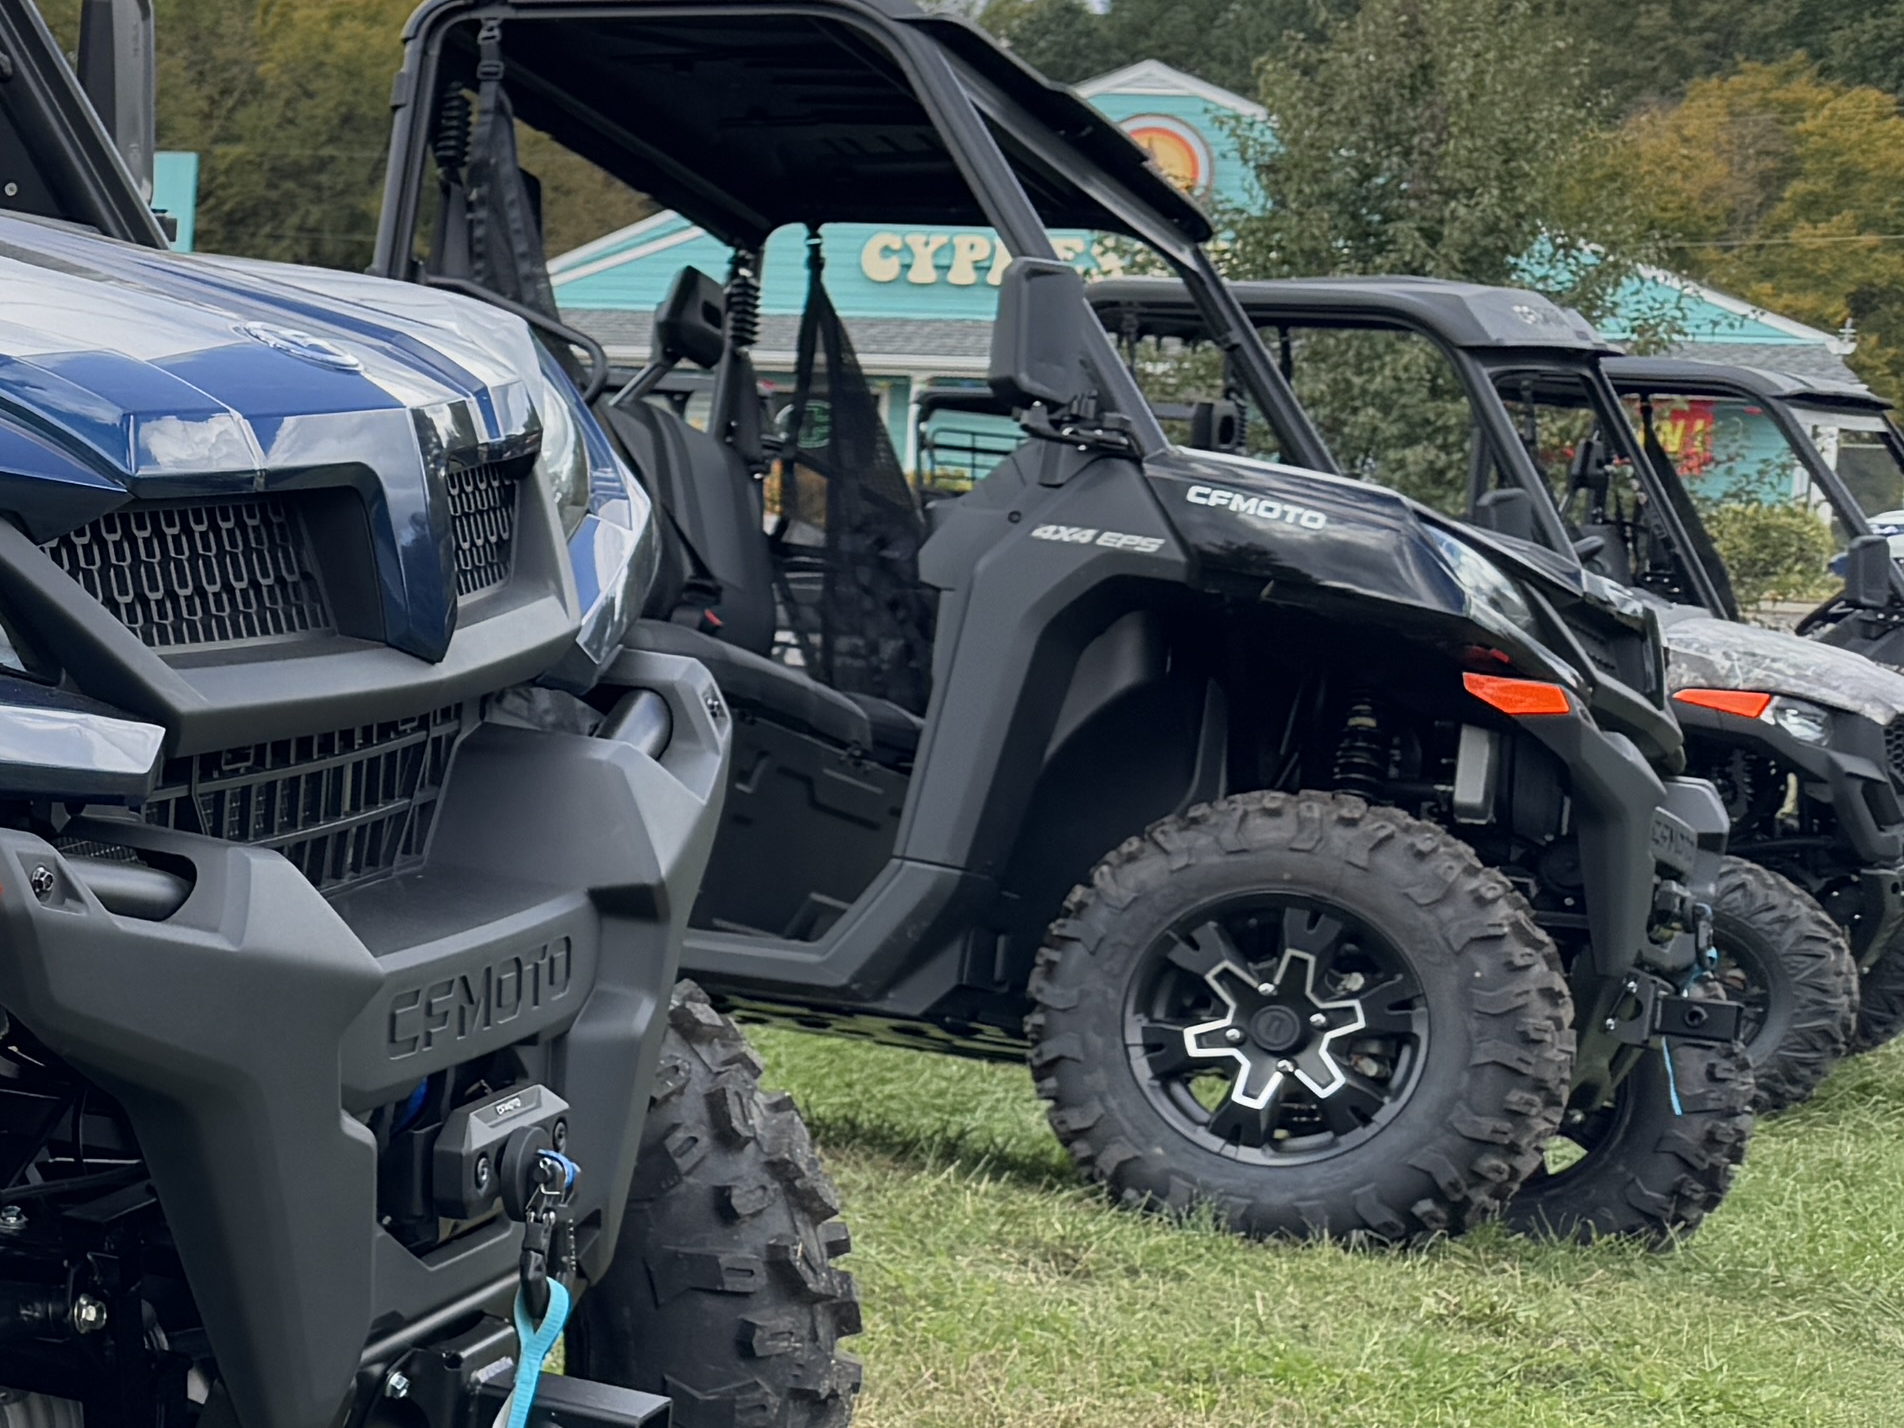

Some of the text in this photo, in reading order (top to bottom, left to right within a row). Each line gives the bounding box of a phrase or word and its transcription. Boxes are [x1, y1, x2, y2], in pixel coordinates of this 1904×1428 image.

[1186, 484, 1328, 531] CFMOTO
[1031, 524, 1167, 553] 4X4 EPS
[388, 935, 572, 1061] CFMOTO
